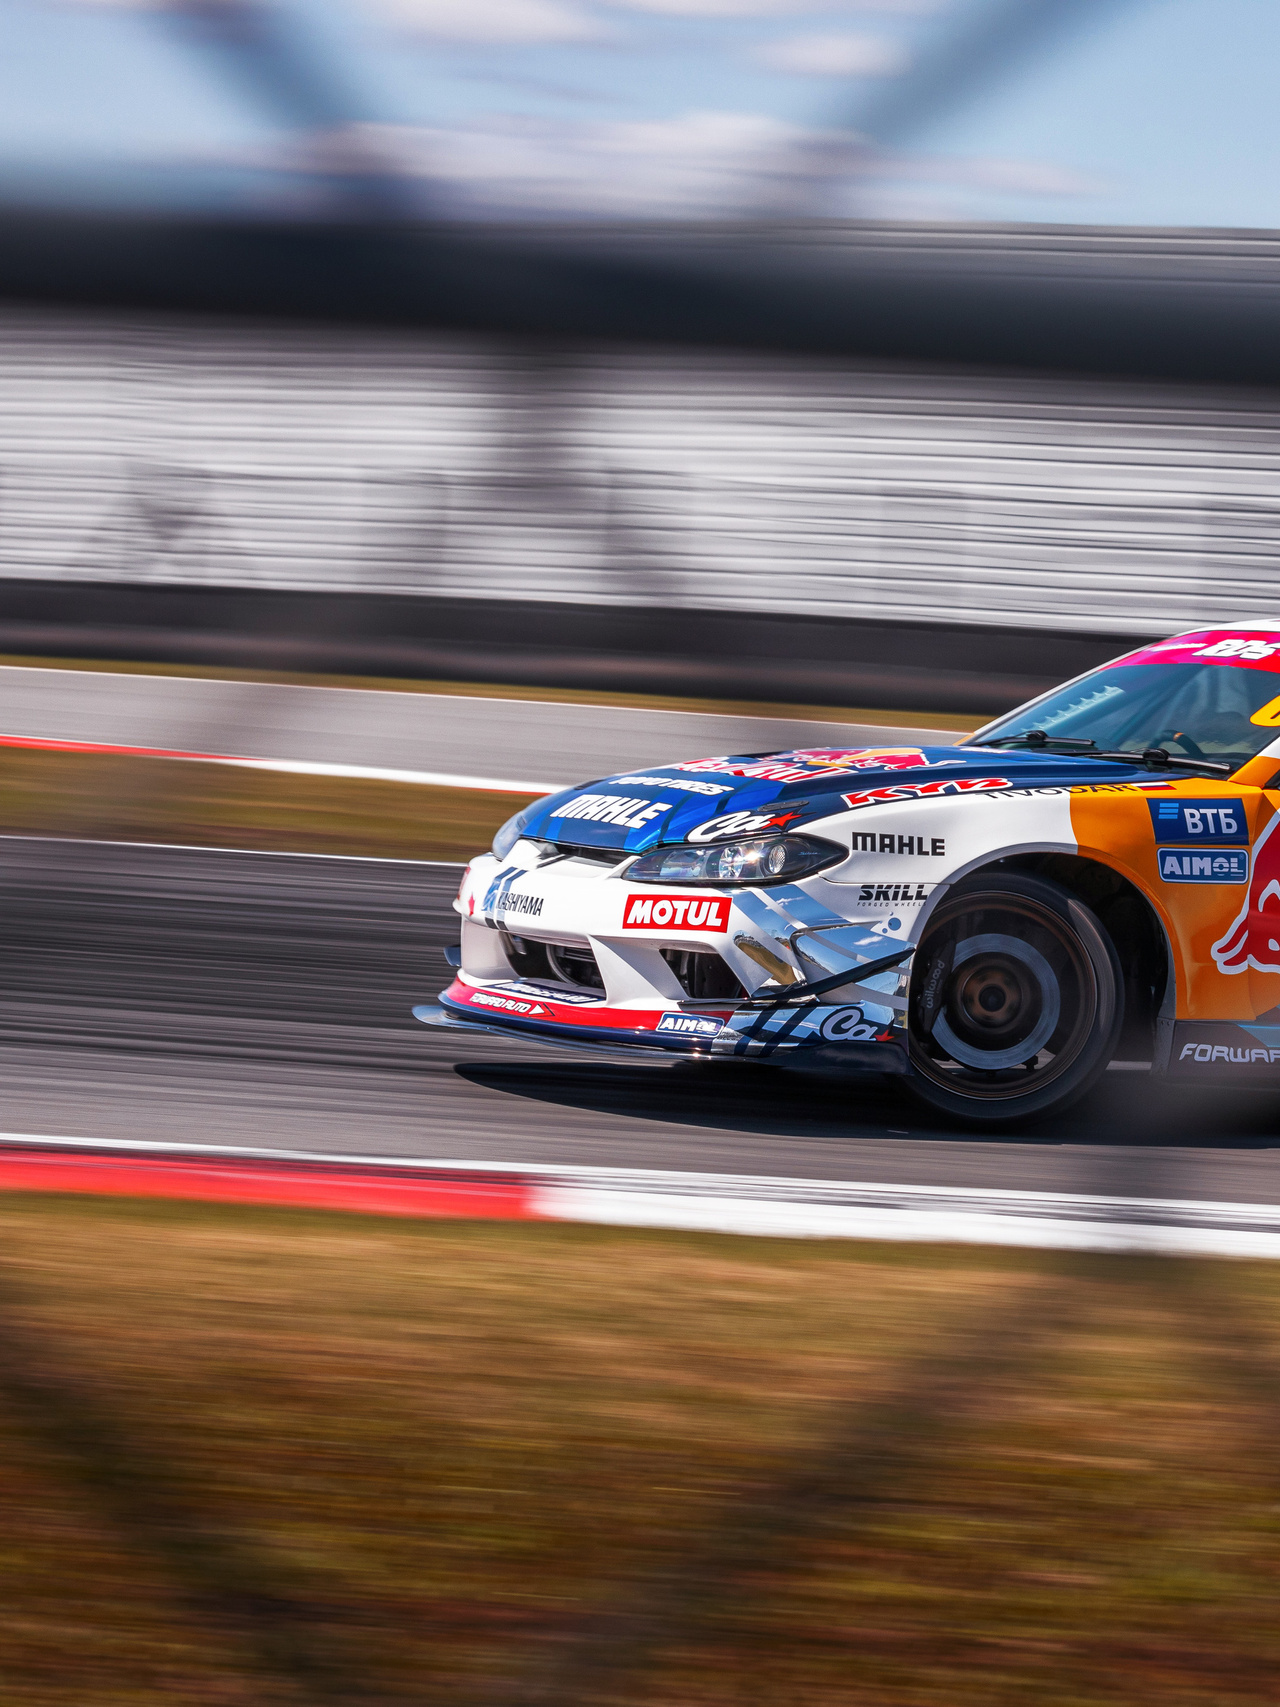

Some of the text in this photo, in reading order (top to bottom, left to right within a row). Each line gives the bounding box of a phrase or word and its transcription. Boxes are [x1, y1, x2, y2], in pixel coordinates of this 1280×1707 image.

[844, 777, 1013, 808] KYB
[549, 794, 674, 829] MAHLE
[1183, 808, 1238, 833] ВТБ
[852, 831, 945, 856] MAHLE
[1163, 856, 1244, 877] AIMOL
[858, 885, 928, 901] SKILL
[626, 899, 722, 927] MOTUL
[926, 959, 946, 1009] wilwood
